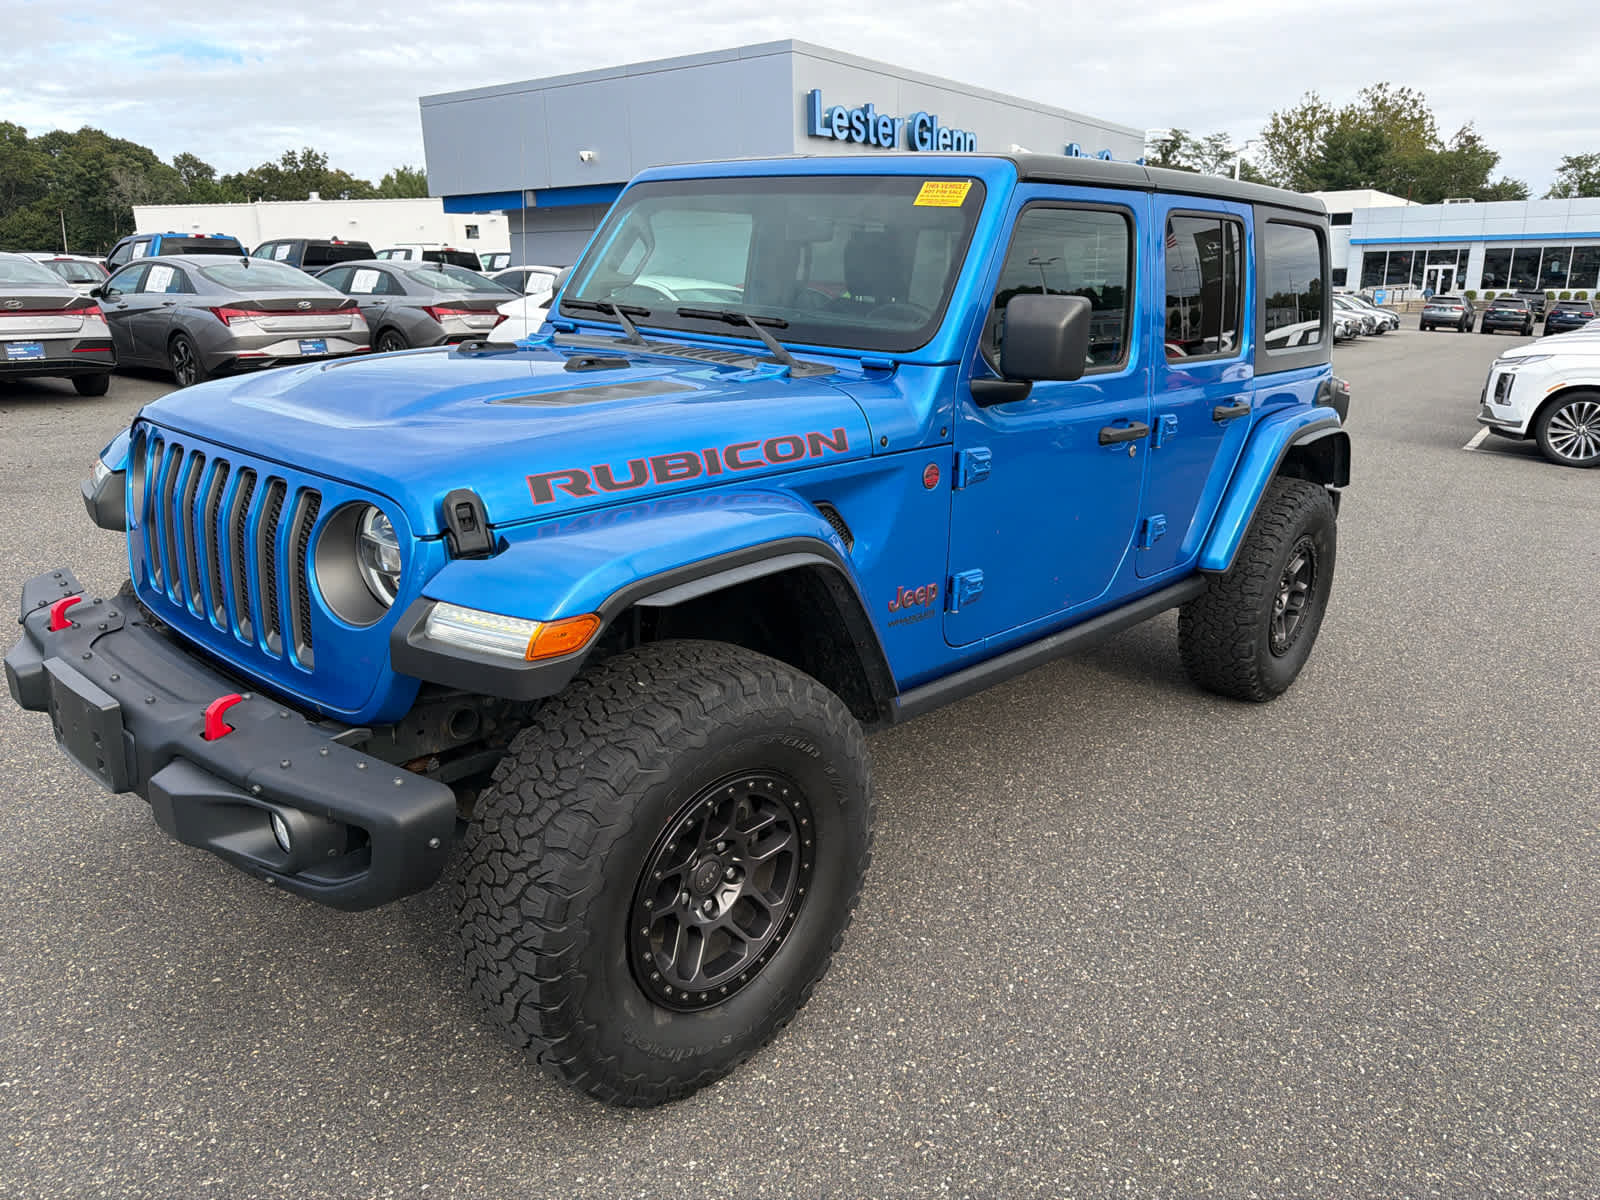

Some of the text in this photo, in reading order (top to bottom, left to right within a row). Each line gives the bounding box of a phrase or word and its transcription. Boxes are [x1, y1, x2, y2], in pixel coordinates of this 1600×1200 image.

[808, 90, 977, 152] Lester Glenn
[525, 428, 850, 505] RUBICON
[888, 583, 938, 613] Jeep
